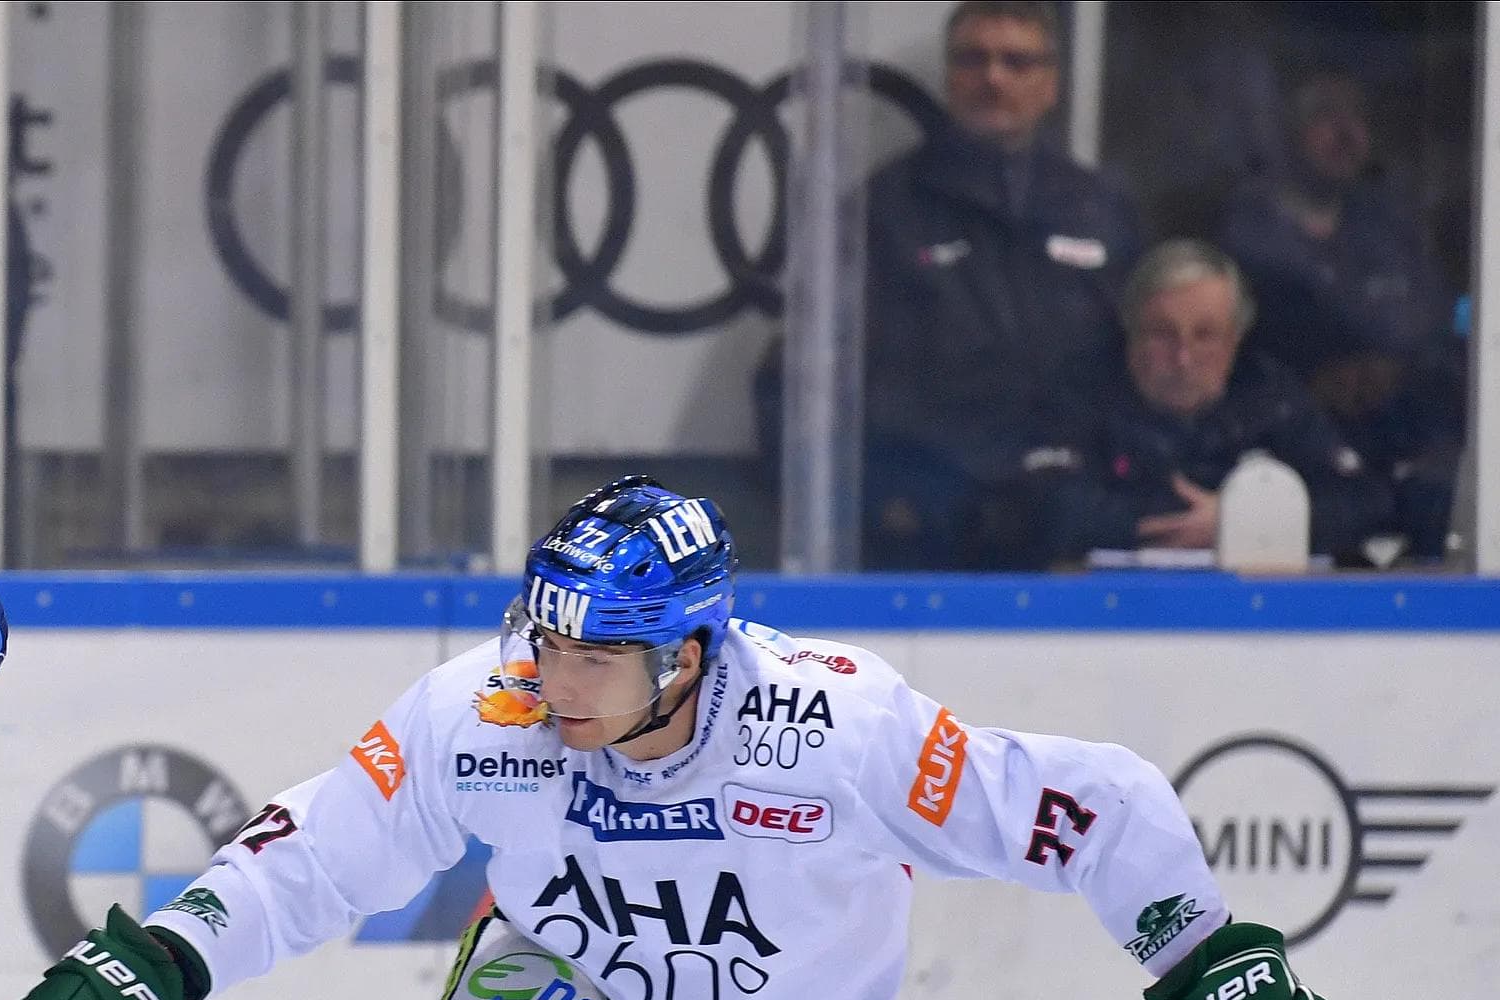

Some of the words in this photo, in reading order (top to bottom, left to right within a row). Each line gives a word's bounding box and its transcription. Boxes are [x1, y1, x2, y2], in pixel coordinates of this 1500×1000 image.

[648, 497, 718, 564] LEW
[527, 575, 592, 640] LEW
[737, 683, 835, 730] AHA
[359, 736, 398, 790] UKA
[455, 751, 568, 779] Dehner
[733, 724, 826, 770] 360°
[916, 715, 962, 813] KUK
[51, 752, 255, 832] BMW
[455, 781, 540, 794] RECYCLING
[731, 798, 825, 834] DEL
[1024, 786, 1098, 867] 77
[1193, 817, 1333, 873] MINI
[530, 854, 783, 958] AHA
[1122, 898, 1208, 966] PANTHER
